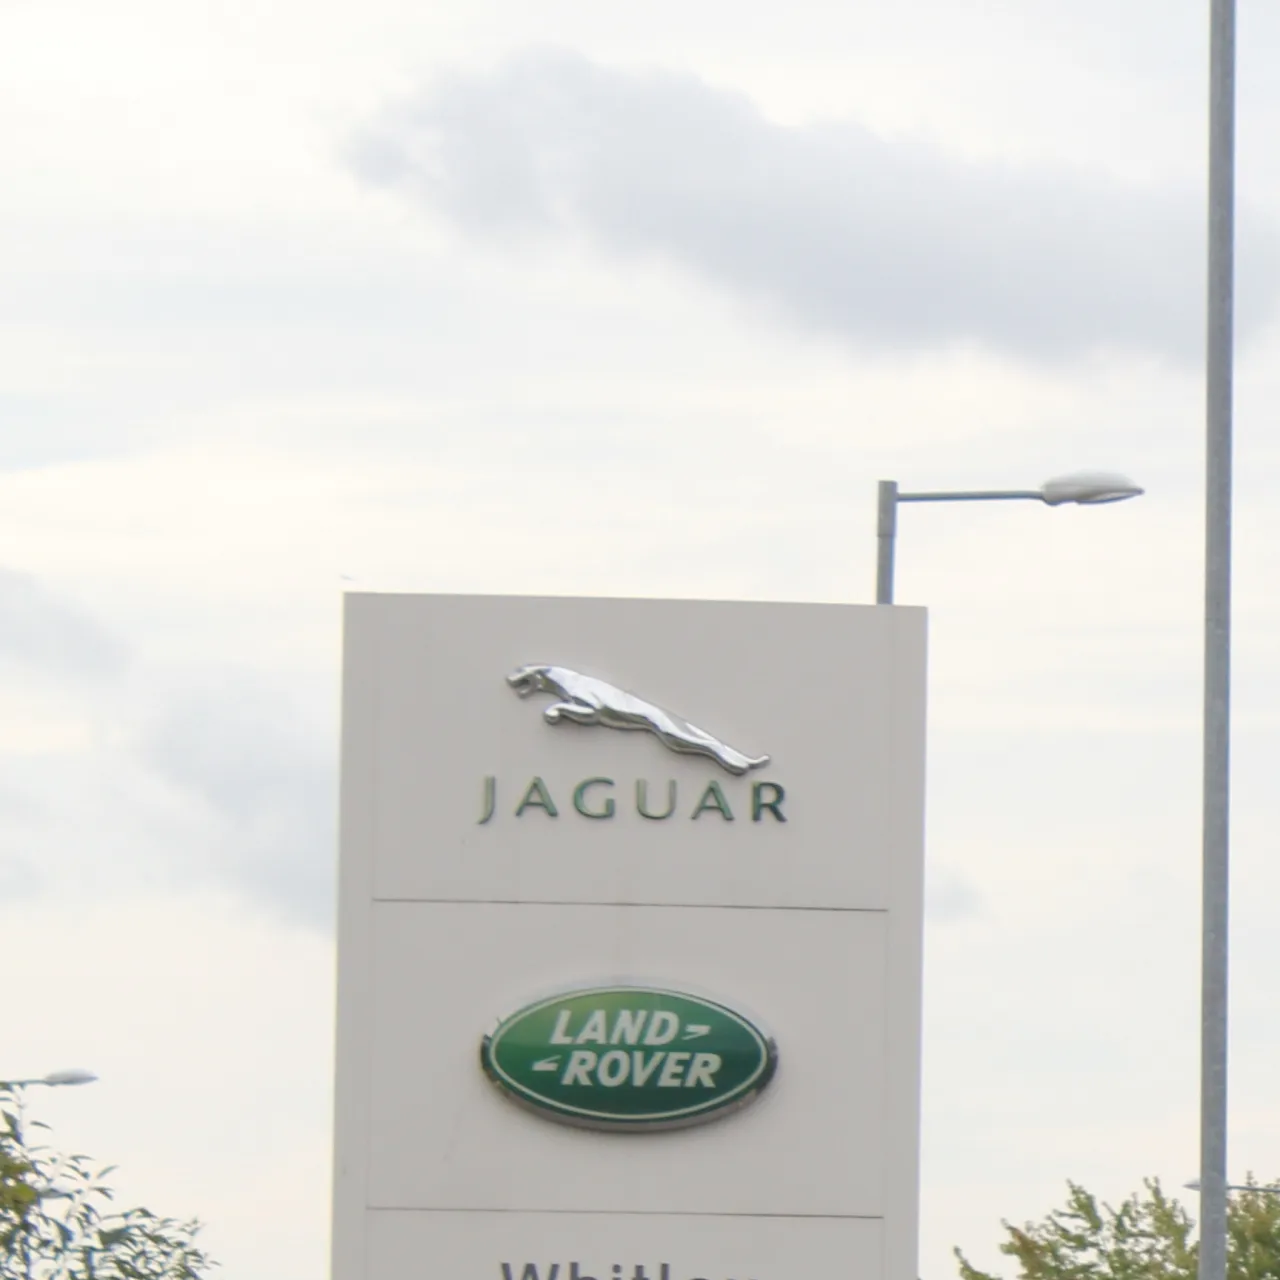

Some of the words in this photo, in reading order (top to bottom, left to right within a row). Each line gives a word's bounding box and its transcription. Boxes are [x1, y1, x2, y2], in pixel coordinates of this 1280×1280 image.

[477, 776, 787, 825] JAGUAR
[549, 1009, 680, 1046] LAND
[560, 1050, 722, 1088] ROVER
